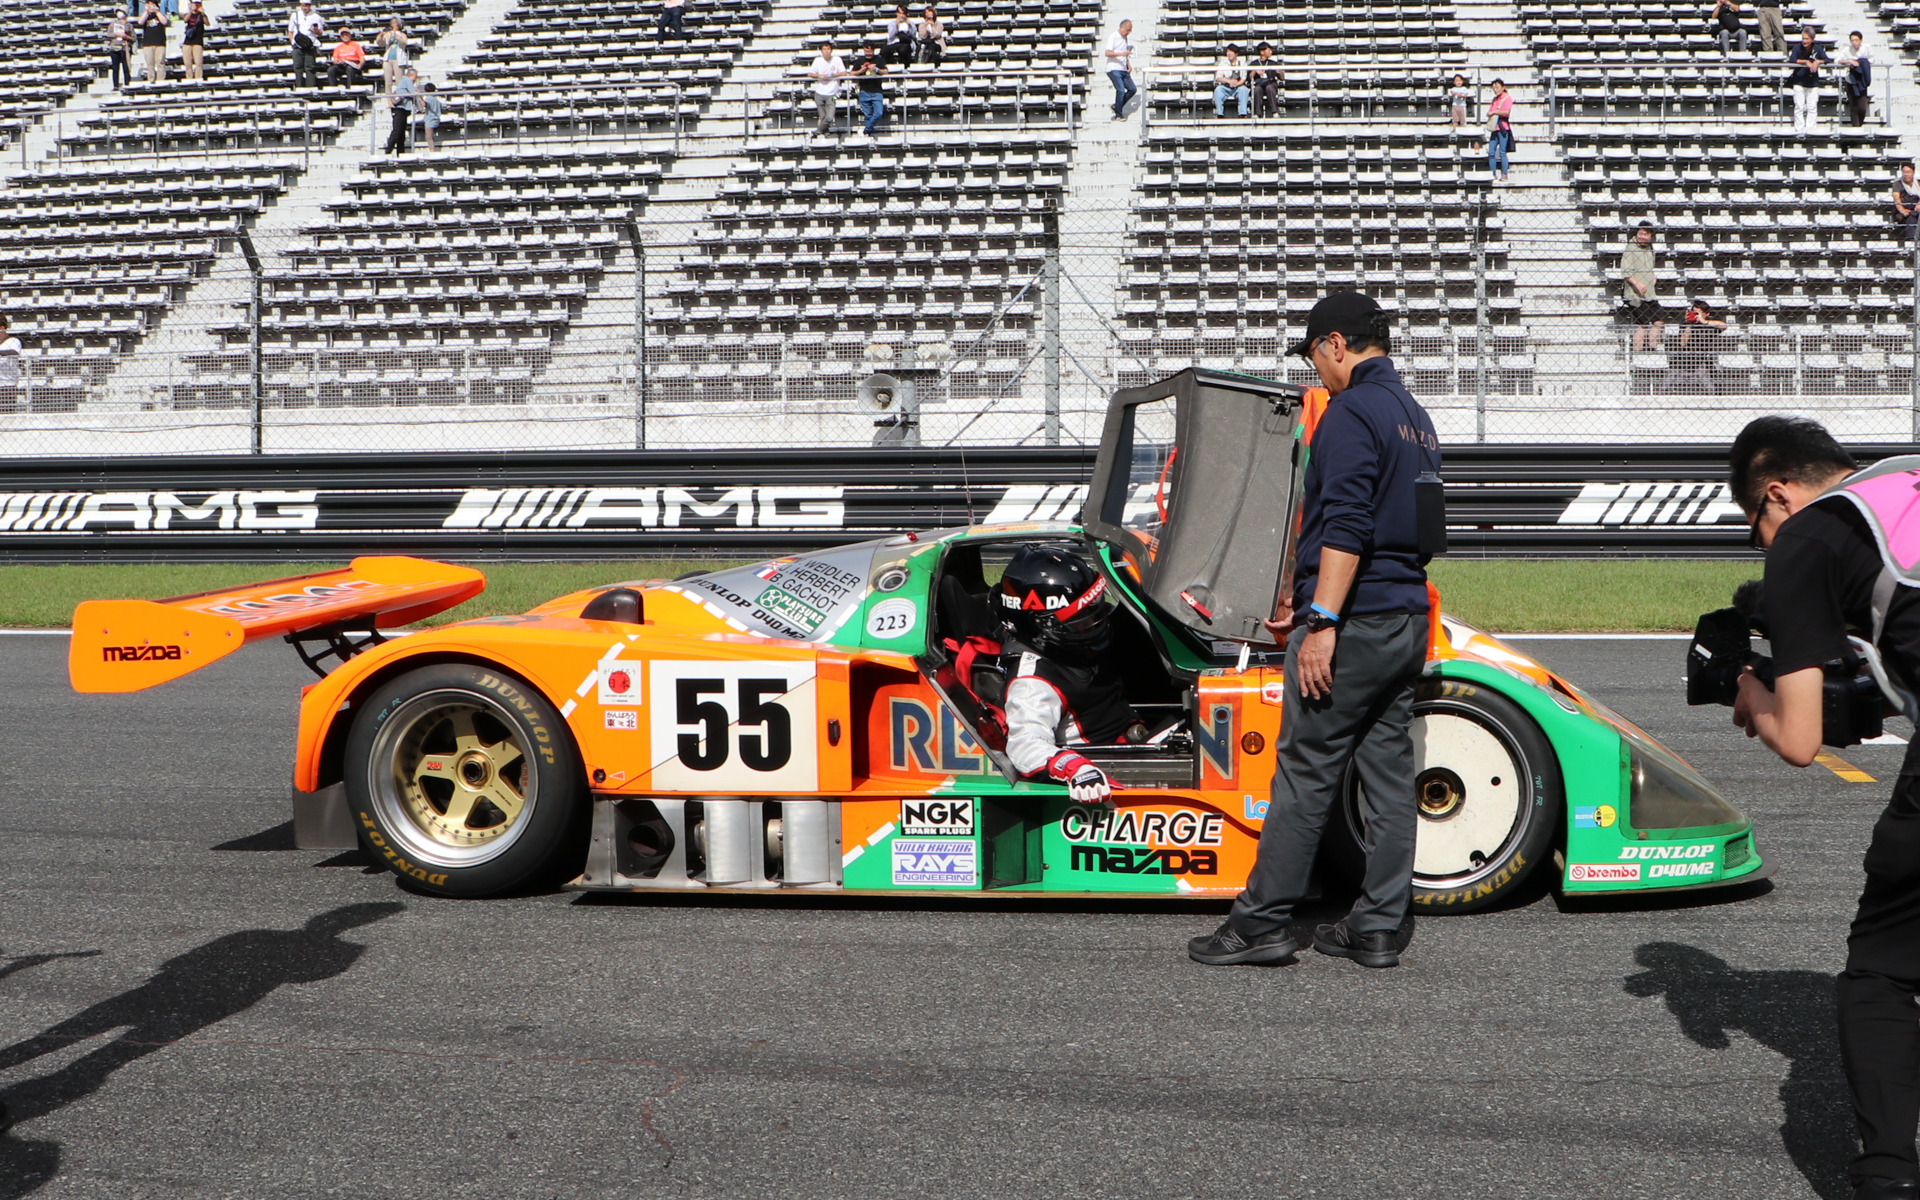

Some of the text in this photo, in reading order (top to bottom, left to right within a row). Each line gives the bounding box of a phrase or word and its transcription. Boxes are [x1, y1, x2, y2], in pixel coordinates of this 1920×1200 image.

[1398, 424, 1438, 452] MAZD
[67, 492, 318, 530] AMG
[565, 487, 843, 527] AMG
[779, 564, 851, 600] J. HERBERT
[805, 559, 861, 588] WEIDLER
[769, 573, 839, 612] B. GACHOT
[1001, 589, 1070, 610] TERADA
[691, 578, 806, 640] DUNLOP D40/M2
[781, 595, 824, 624] PLAYSURE
[784, 608, 808, 625] CLUB
[876, 614, 907, 633] 223
[608, 678, 631, 690] 日本
[476, 674, 555, 764] DUNLOP
[675, 678, 792, 772] 55
[905, 802, 970, 826] NGK
[1060, 806, 1225, 847] CHARGE
[360, 812, 449, 886] DUNLOP
[895, 843, 973, 853] VOLK RACING
[1617, 844, 1715, 860] DUNLOP
[894, 854, 974, 873] RAYS
[895, 873, 974, 882] ENGINEERING
[1413, 849, 1527, 906] DUNLOP
[1588, 866, 1638, 878] brembo
[1648, 861, 1715, 878] D40/M2
